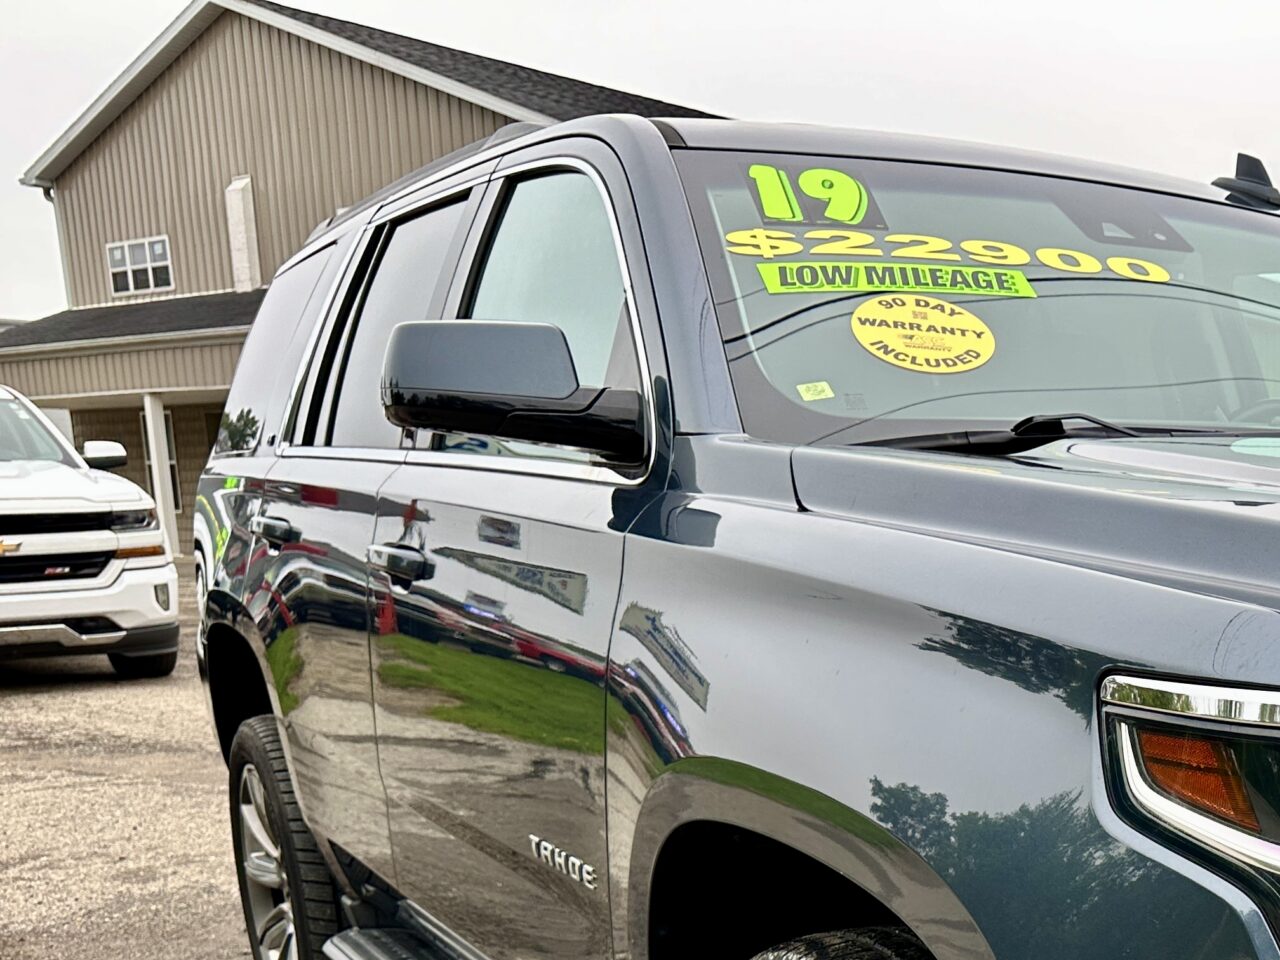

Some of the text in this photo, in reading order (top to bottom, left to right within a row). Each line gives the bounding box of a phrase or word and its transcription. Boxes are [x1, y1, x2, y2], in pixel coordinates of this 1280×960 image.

[748, 164, 868, 225] 19
[725, 228, 1171, 282] $22900
[778, 264, 1019, 293] LOW MILEAGE
[878, 297, 906, 310] 90
[914, 298, 964, 317] DAY
[857, 316, 986, 339] WARRANTY
[869, 340, 981, 368] INCLUDED
[528, 833, 597, 890] TAHOE
